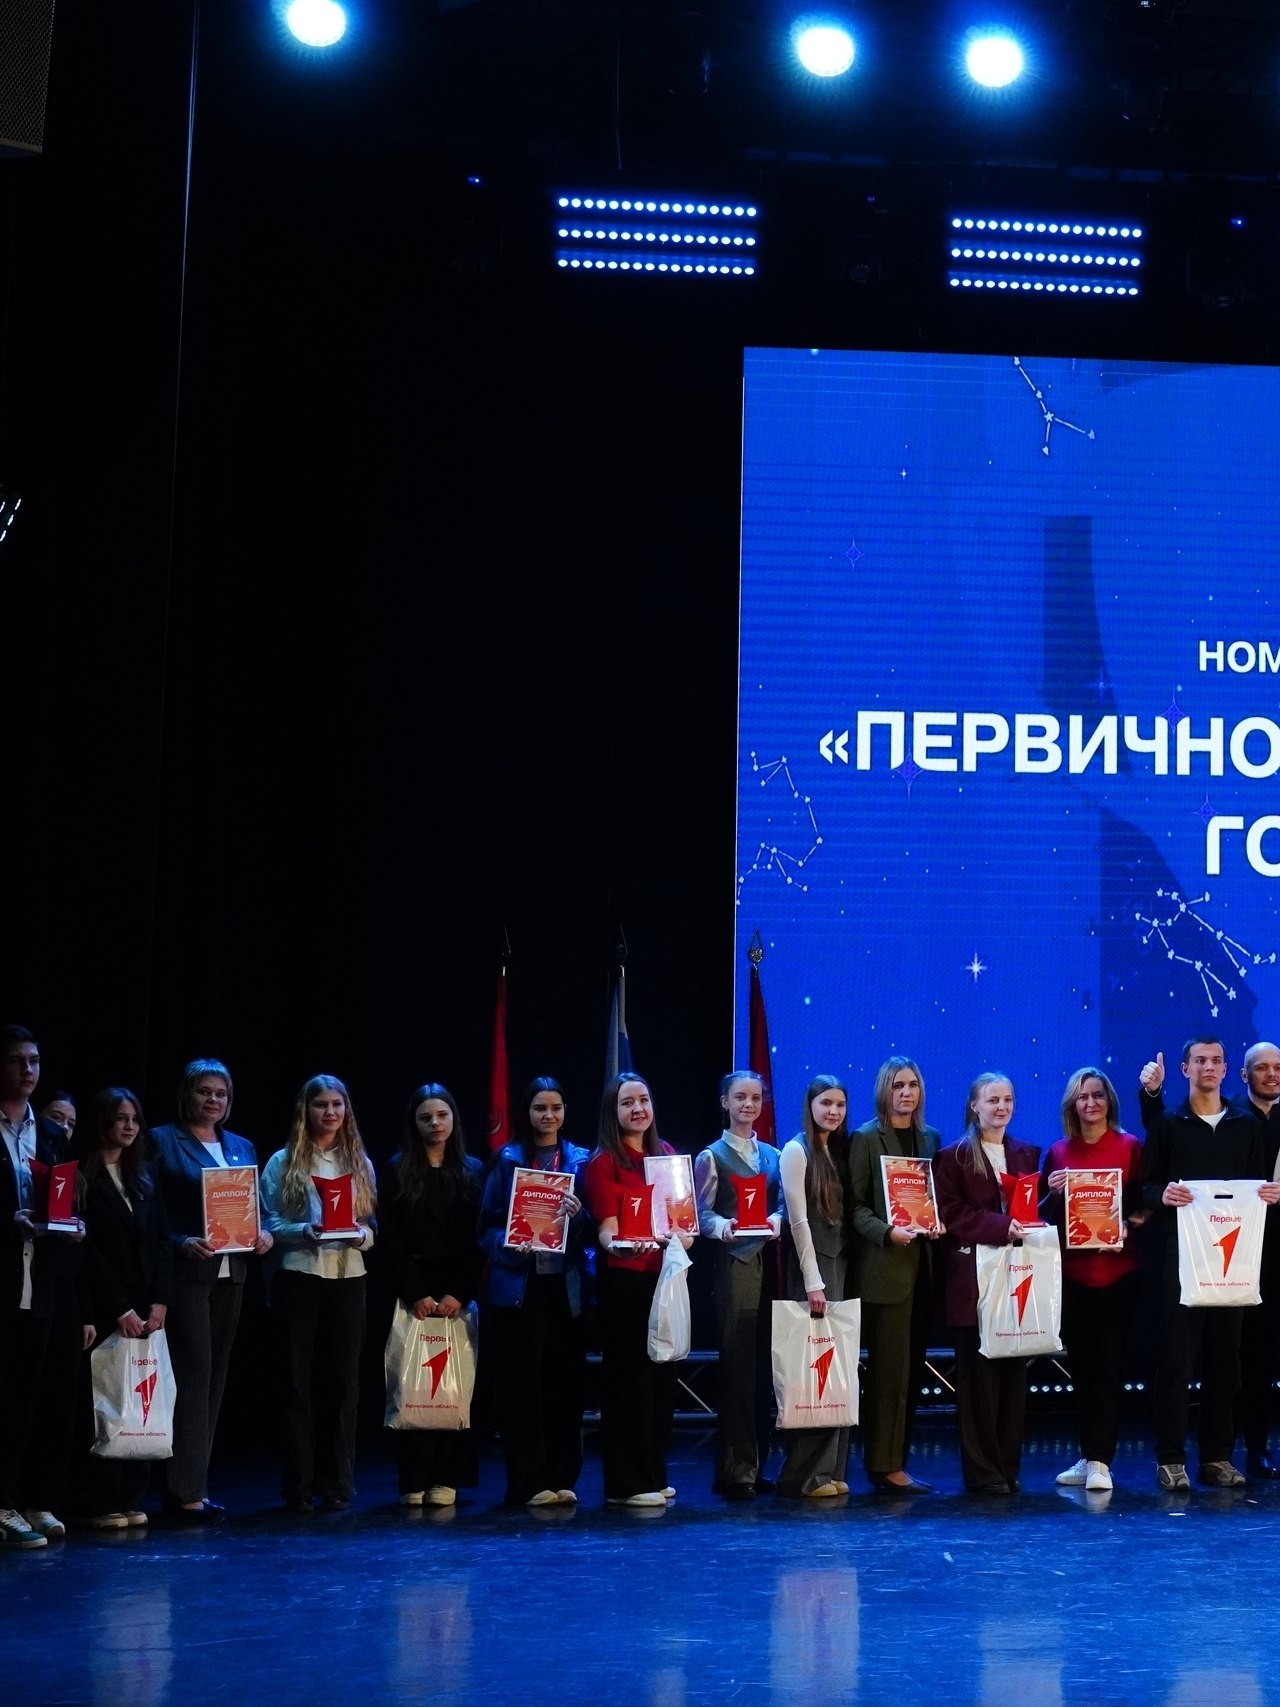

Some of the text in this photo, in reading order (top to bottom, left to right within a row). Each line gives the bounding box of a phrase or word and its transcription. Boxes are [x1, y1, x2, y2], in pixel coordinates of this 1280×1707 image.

[893, 1177, 926, 1185] ДИПЛОМ
[212, 1190, 248, 1199] ДИПЛОМ
[522, 1190, 562, 1201] ДИПЛОМ
[1075, 1191, 1112, 1199] ДИПЛОМ
[419, 1333, 452, 1345] Первы
